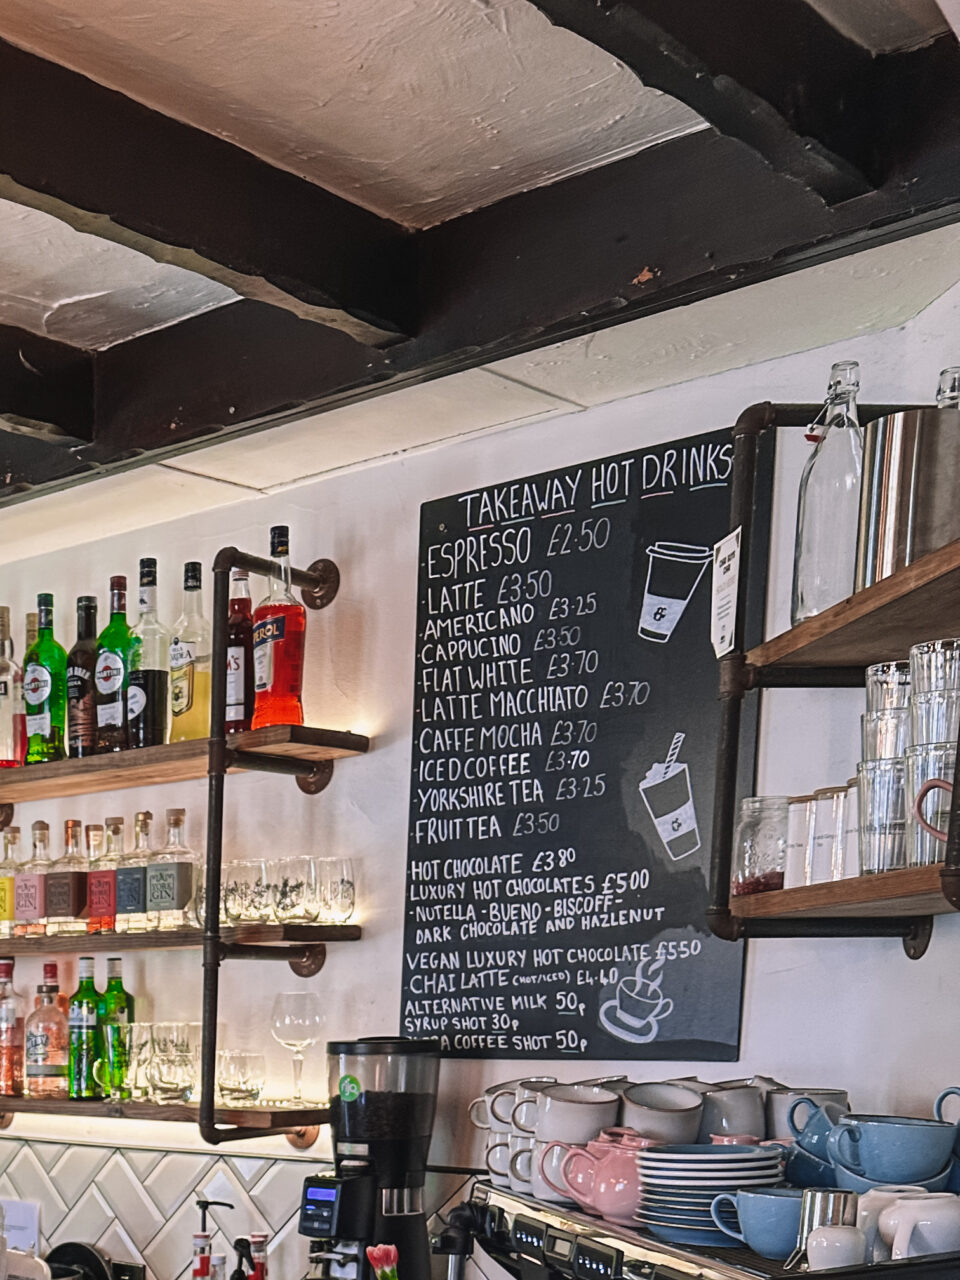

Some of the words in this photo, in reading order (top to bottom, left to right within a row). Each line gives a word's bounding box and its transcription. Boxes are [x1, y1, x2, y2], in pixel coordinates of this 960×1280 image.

[458, 469, 582, 527] TAKEAWAY
[592, 459, 634, 502] HOT
[642, 444, 733, 489] DRINKS
[427, 527, 531, 579] ESPRESSO
[547, 517, 611, 557] £2.50
[427, 579, 486, 614] LATTE
[496, 570, 553, 604] £3.50
[423, 603, 534, 640] AMERICANO
[548, 593, 597, 621] £3.25
[421, 633, 521, 665] CAPPUCINO
[533, 626, 581, 651] £3.50
[422, 666, 462, 693] FLAT
[468, 658, 533, 690] WHITE
[546, 650, 599, 680] £3.70
[421, 691, 482, 723] LATTE
[490, 685, 588, 717] MACCHIATO
[599, 681, 650, 709] £3.70
[419, 728, 474, 754] CAFFE
[480, 723, 542, 750] MOCHA
[550, 720, 597, 746] £3.70
[418, 758, 460, 782] ICED
[464, 753, 531, 780] COFFEE
[545, 750, 590, 773] £3.70
[417, 781, 504, 813] YORKSHIRE
[509, 778, 544, 803] TEA
[555, 773, 607, 800] £3.25
[415, 818, 465, 845] FRUIT
[466, 815, 502, 840] TEA
[512, 812, 560, 837] £3.50
[410, 859, 440, 881] HOT
[443, 853, 523, 878] CHOCOLATE
[409, 882, 466, 903] LUXURY
[473, 879, 502, 900] HOT
[505, 875, 595, 898] CHOCOLATES
[415, 925, 451, 945] DARK
[460, 920, 538, 941] CHOCOLATE
[545, 917, 575, 934] AND
[581, 907, 665, 930] HAZLENUT
[406, 951, 460, 971] VEGAN
[466, 950, 527, 969] LUXURY
[533, 949, 564, 967] HOT
[566, 944, 652, 964] CHOCOLATE
[409, 974, 456, 995] CHAI
[461, 970, 510, 990] LATTE
[405, 995, 505, 1016] ALTERNATIVE
[511, 993, 547, 1010] MILK
[404, 1016, 448, 1032] SYRUP
[452, 1015, 487, 1031] SHOT
[454, 1035, 509, 1049] COFFEE
[512, 1035, 552, 1050] SHOT
